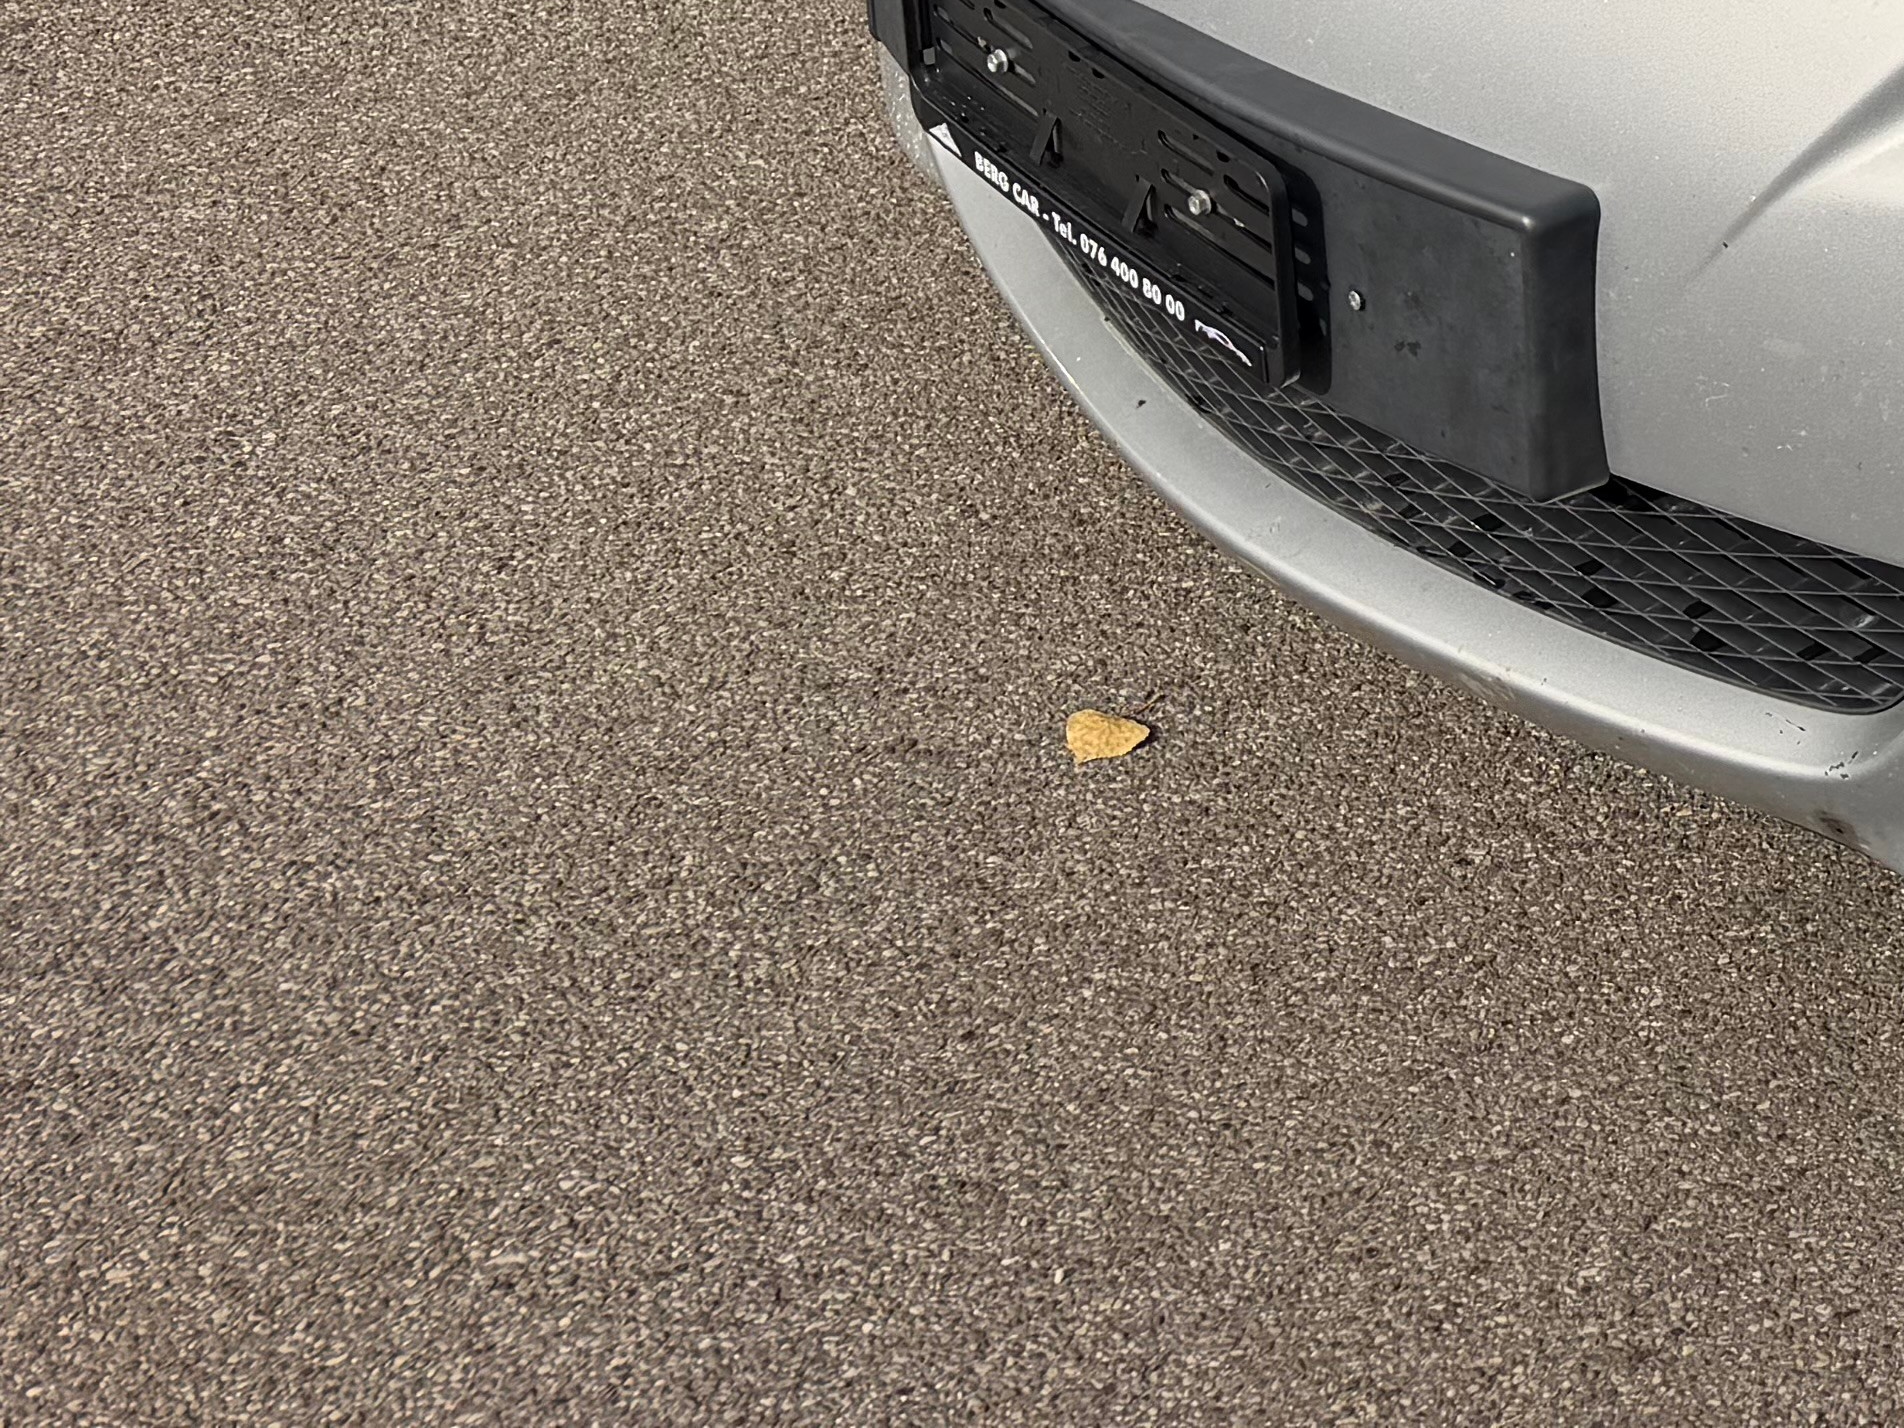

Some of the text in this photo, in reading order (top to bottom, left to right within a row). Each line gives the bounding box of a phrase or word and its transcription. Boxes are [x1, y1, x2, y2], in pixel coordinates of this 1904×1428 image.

[975, 151, 1010, 192] BERG
[1013, 182, 1040, 217] CAR
[1052, 211, 1077, 245] Tel.
[1080, 233, 1107, 267] 076
[1111, 256, 1139, 289] 400
[1142, 277, 1162, 305] 80
[1165, 294, 1185, 322] 00
